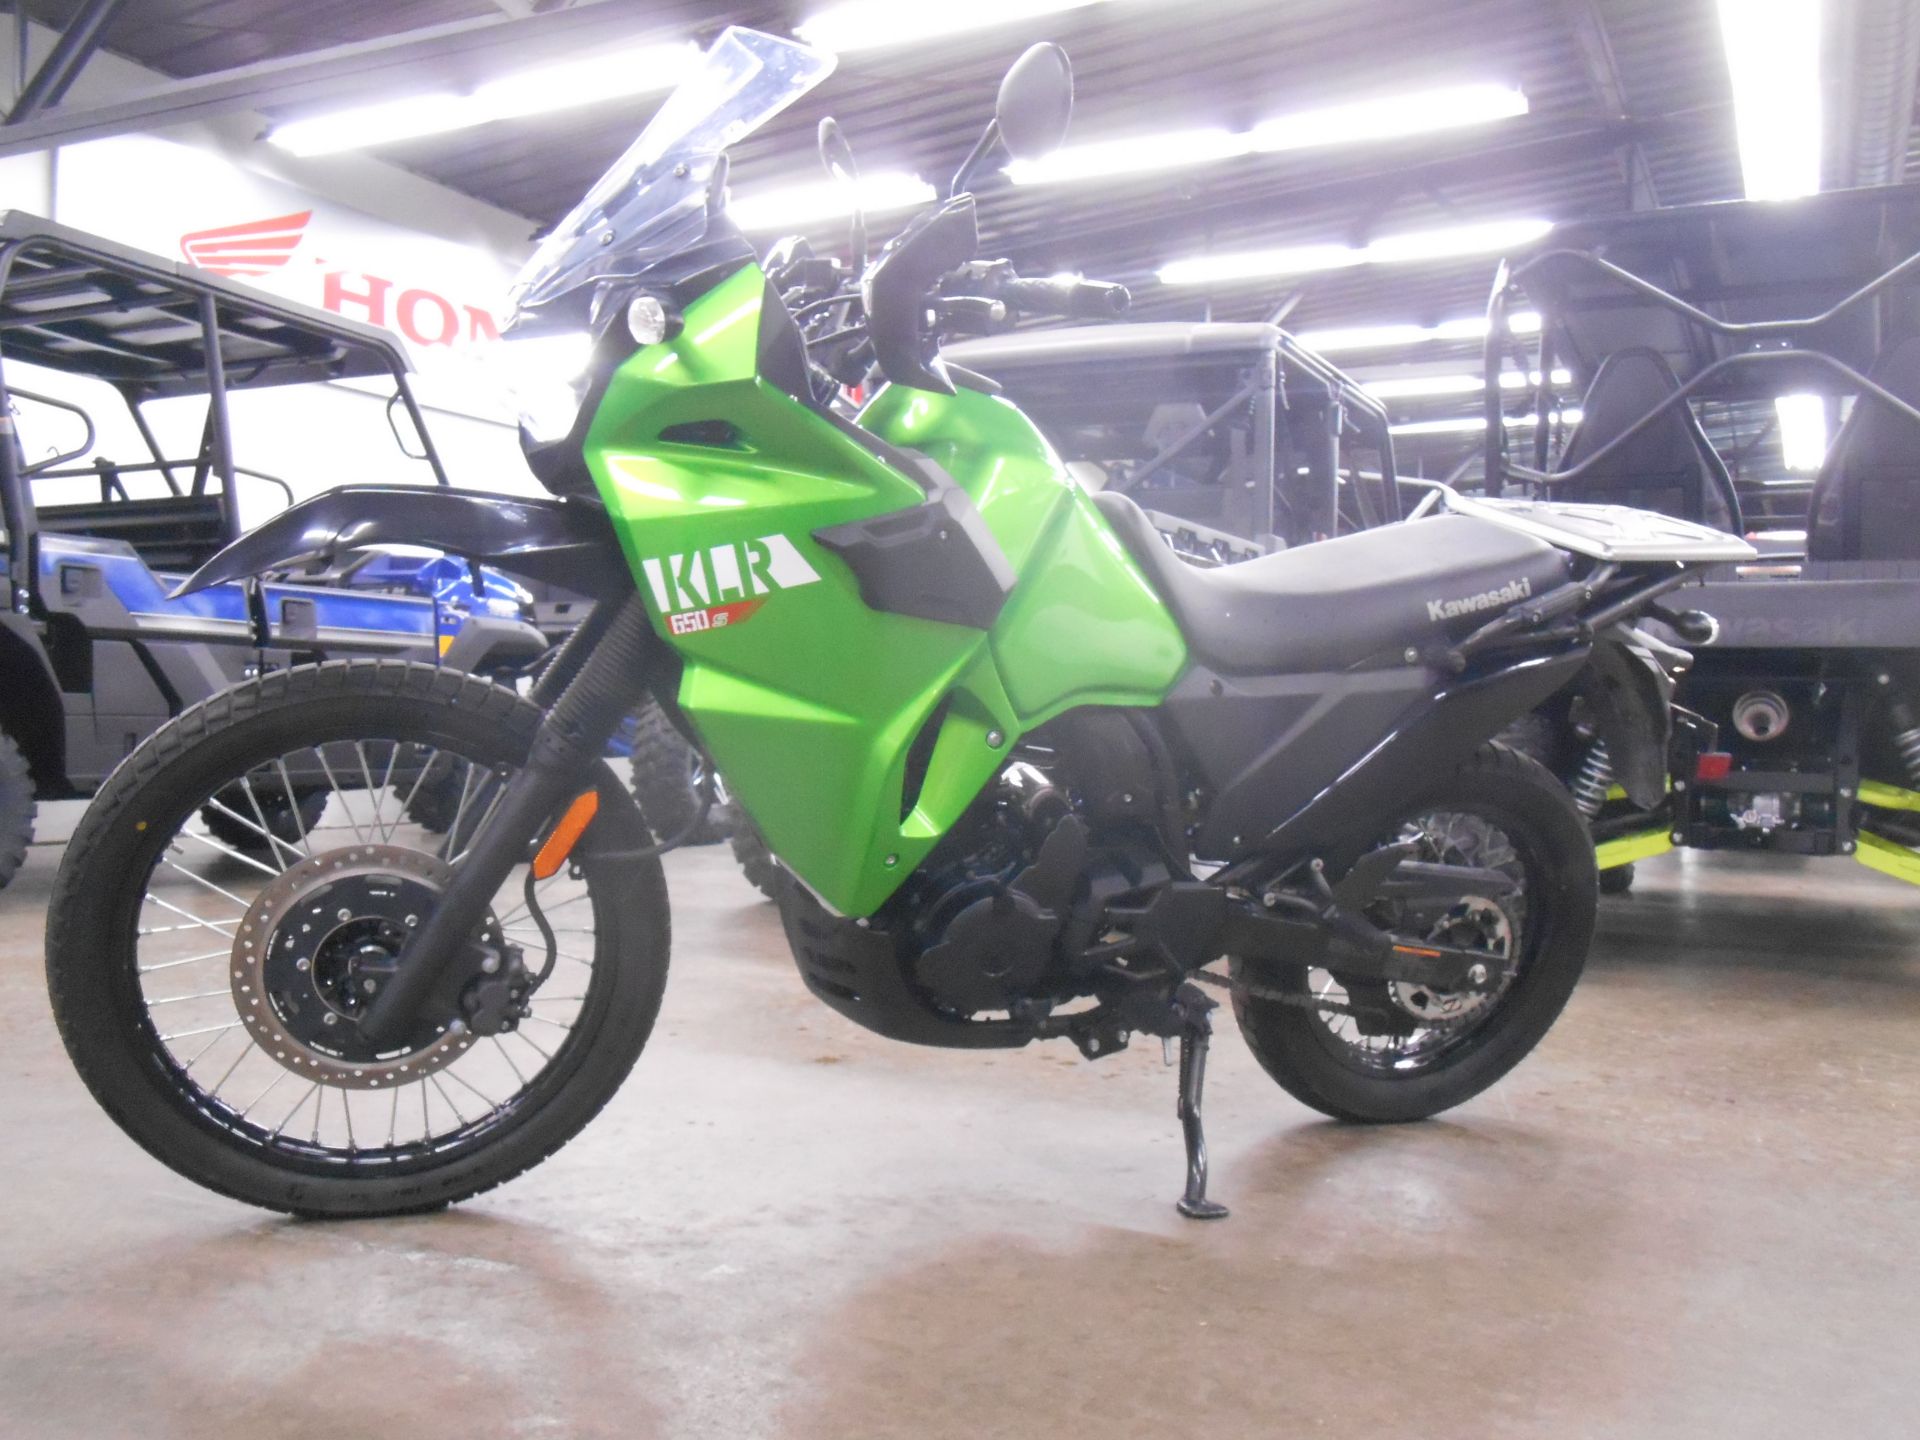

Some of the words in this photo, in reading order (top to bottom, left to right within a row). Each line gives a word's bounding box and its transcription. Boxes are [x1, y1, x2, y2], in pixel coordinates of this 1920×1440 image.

[642, 533, 822, 613] KLR
[670, 609, 710, 635] 650
[1426, 577, 1532, 622] Kawasaki
